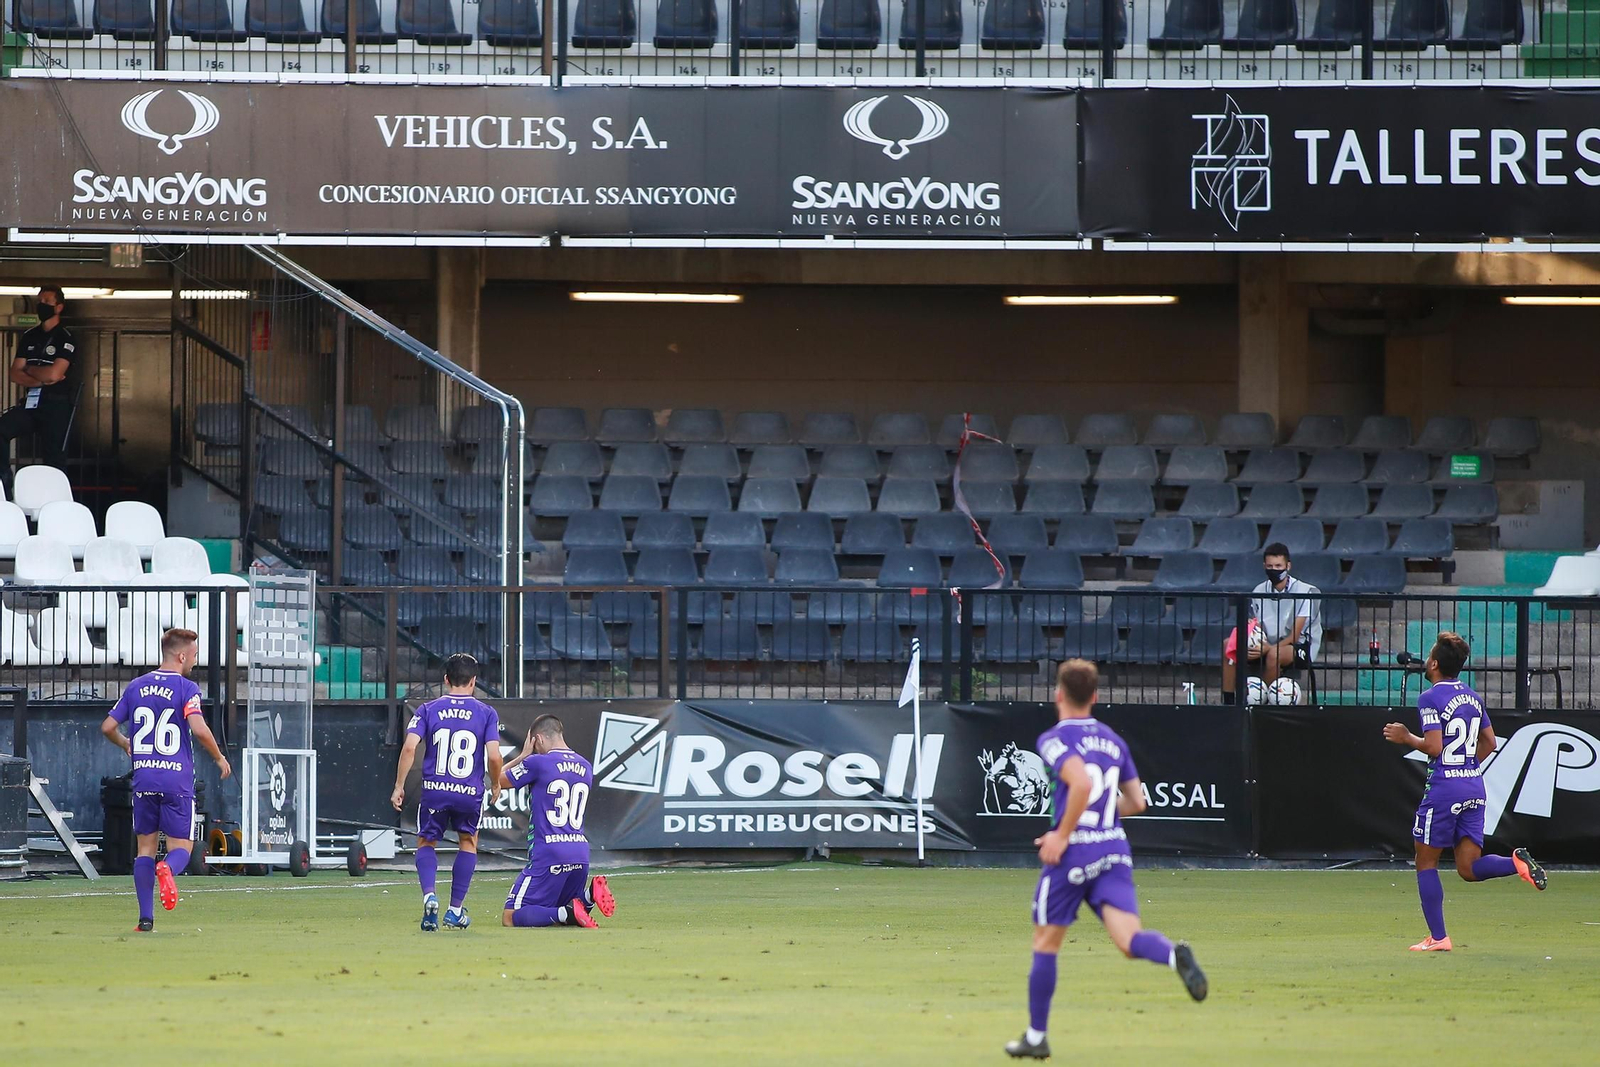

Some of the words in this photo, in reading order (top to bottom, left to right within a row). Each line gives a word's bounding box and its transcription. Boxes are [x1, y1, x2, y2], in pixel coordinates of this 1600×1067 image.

[125, 58, 142, 67] 158
[206, 60, 224, 69] 156
[374, 115, 577, 155] VEHICLES,
[591, 116, 668, 150] S.A.
[1294, 128, 1600, 186] TALLERES
[319, 184, 495, 205] CONCESIONARIO
[501, 185, 589, 205] OFICIAL
[595, 186, 737, 206] SSANGYONG
[72, 208, 134, 222] NUEVA
[142, 206, 268, 222] GENERACIÓN
[793, 214, 856, 226] NUEVA
[867, 212, 1001, 227] GENERACIÓN
[139, 685, 175, 701] ISMAEL
[438, 708, 473, 721] MATOS
[133, 706, 181, 756] 26
[1442, 717, 1481, 766] 24
[432, 728, 477, 779] 18
[556, 761, 586, 777] RAMÓN
[664, 734, 945, 800] Rosell
[423, 780, 477, 796] BENAHAVIS
[1077, 762, 1120, 829] 21
[1117, 782, 1225, 808] ASSAL
[546, 779, 589, 829] 30
[664, 813, 936, 834] DISTRIBUCIONES
